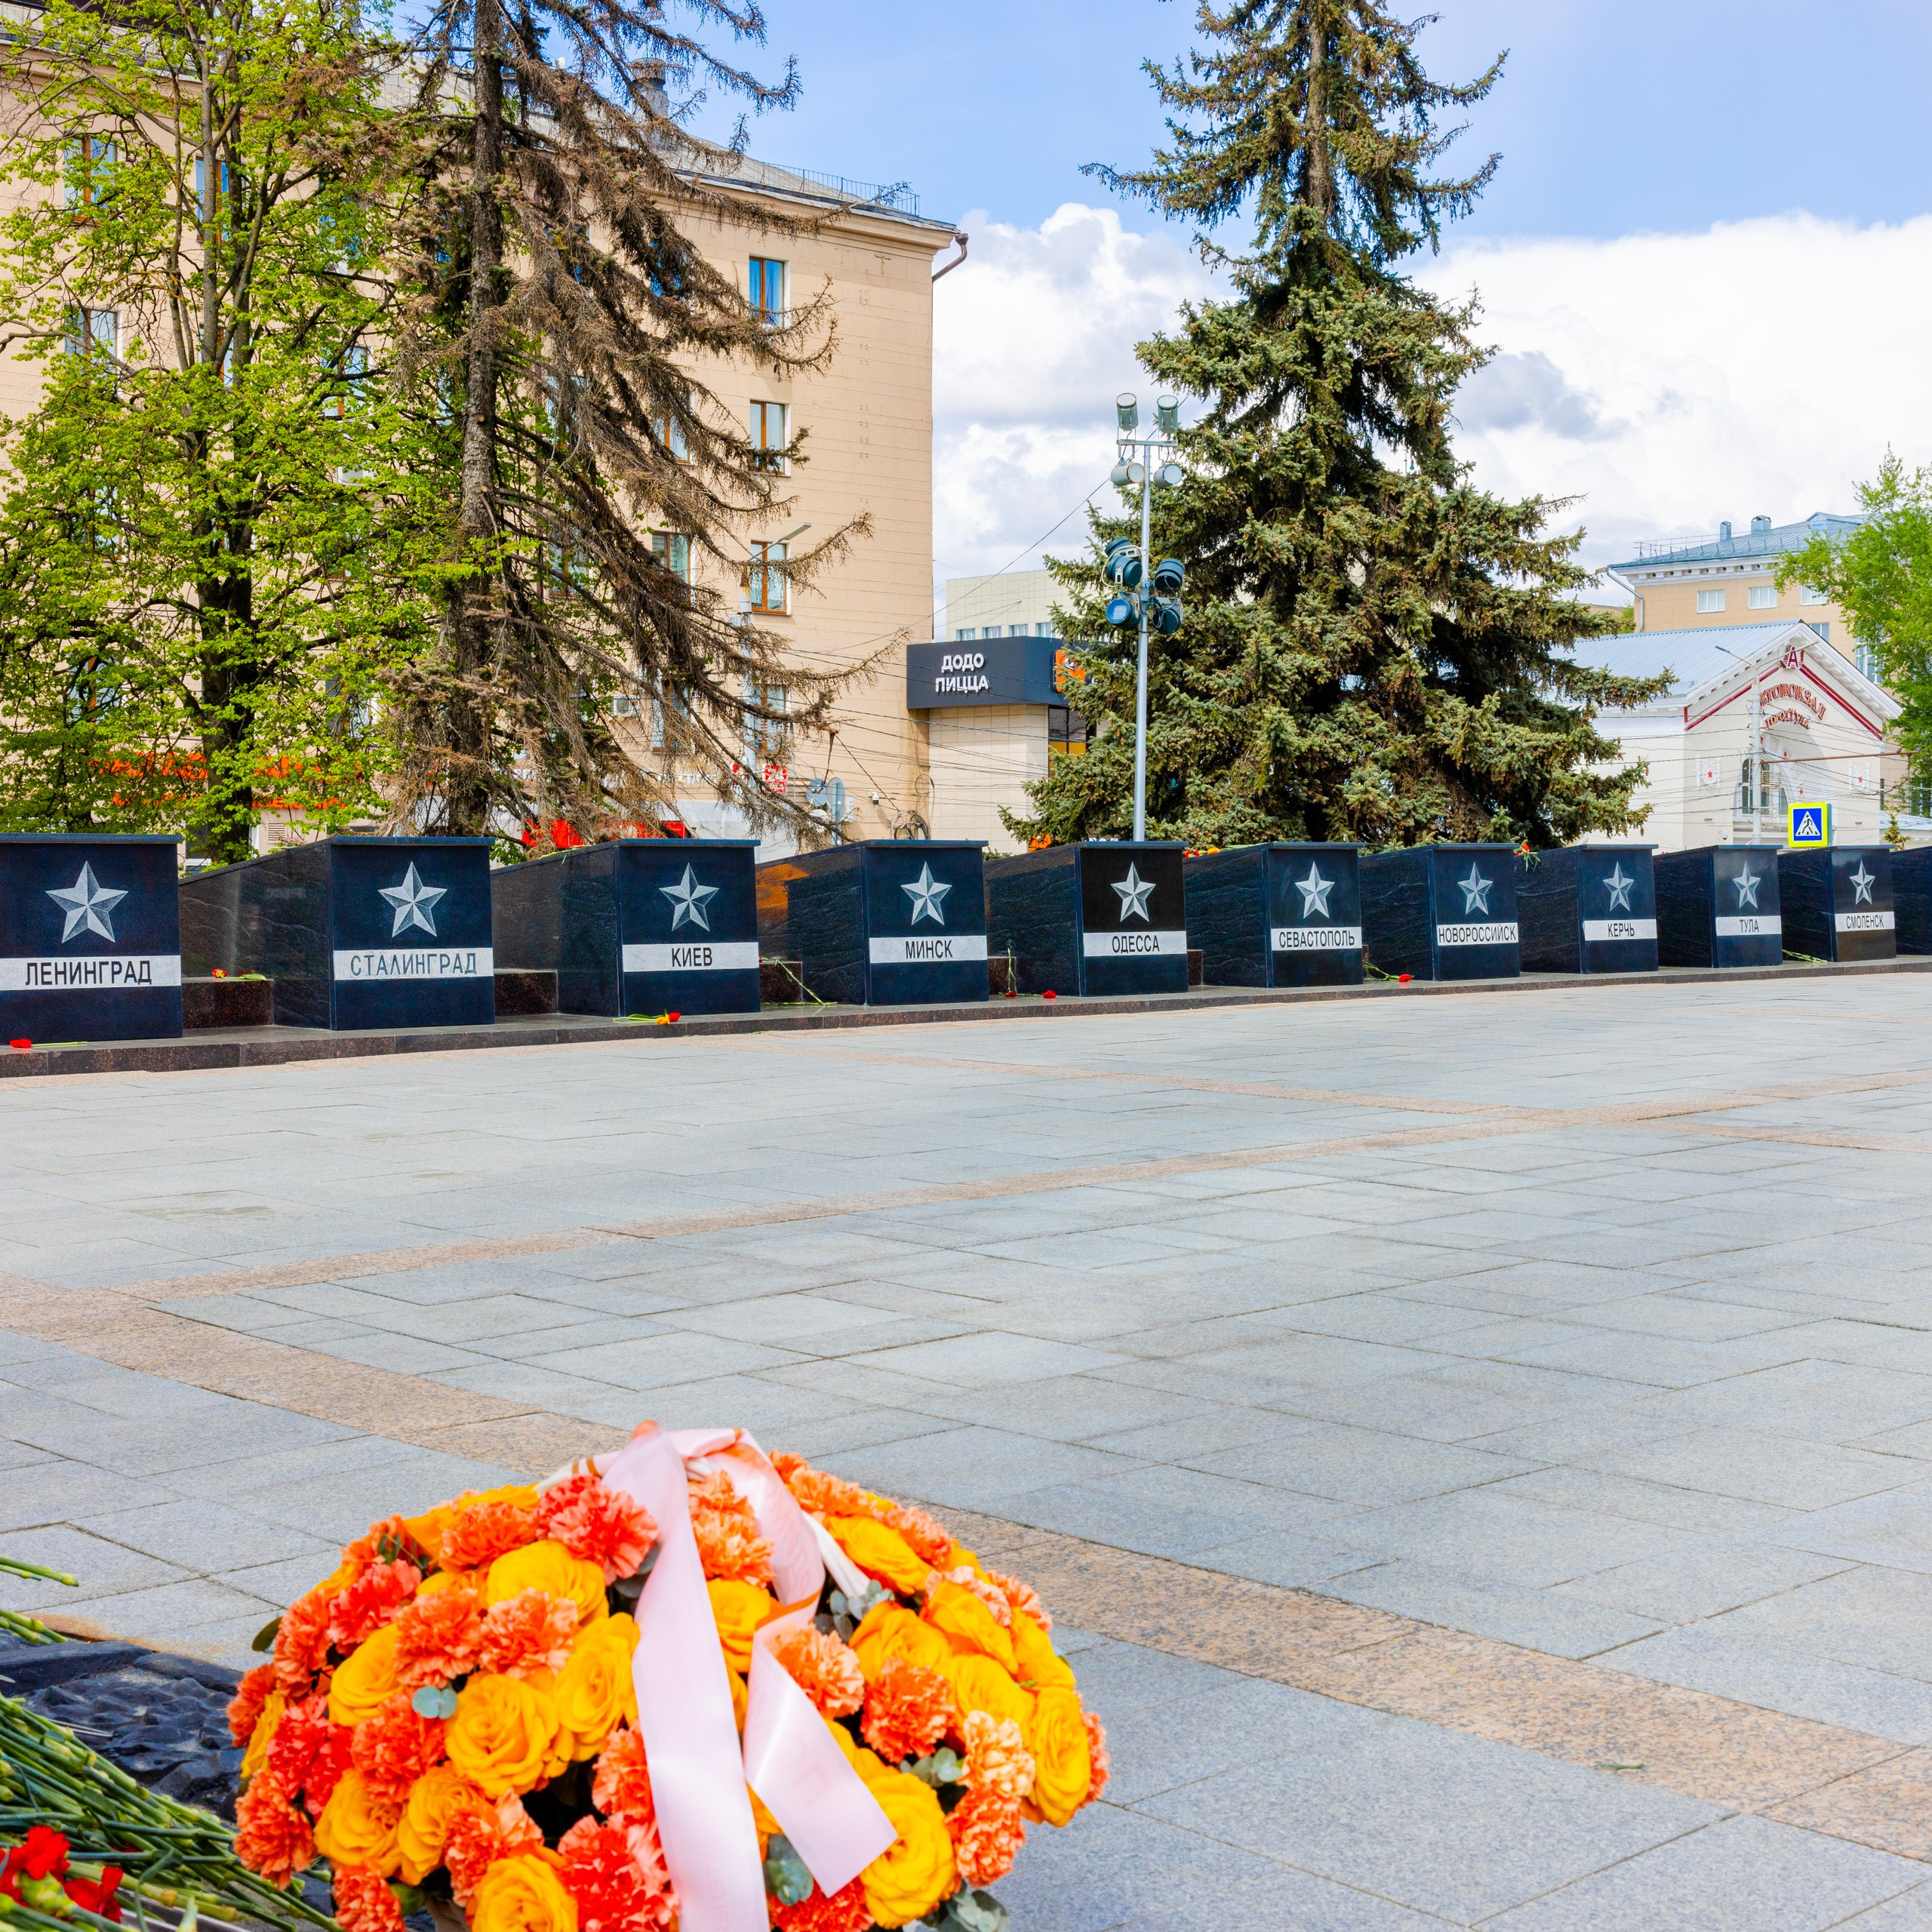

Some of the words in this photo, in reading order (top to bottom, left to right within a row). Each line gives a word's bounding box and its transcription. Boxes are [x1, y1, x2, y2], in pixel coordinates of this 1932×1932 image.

[941, 654, 984, 673] ДОДО
[936, 675, 989, 694] ПИЦЦА
[1760, 684, 1826, 720] ВТОВОКЗАЛ
[1607, 922, 1635, 937] КЕРЧЬ
[1740, 918, 1759, 933] ТУЛА
[1846, 915, 1884, 929] СМОЛЕНСК
[1279, 930, 1355, 948] СЕВАСТОПОЛЬ
[1438, 924, 1516, 943] НОВОРОССИЙСК
[905, 940, 953, 959] МИНСК
[1112, 934, 1160, 954] ОДЕССА
[350, 952, 477, 976] СТАЛИНГРАД
[671, 947, 712, 967] КИЕВ
[26, 961, 152, 986] ЛЕНИНГРАД
